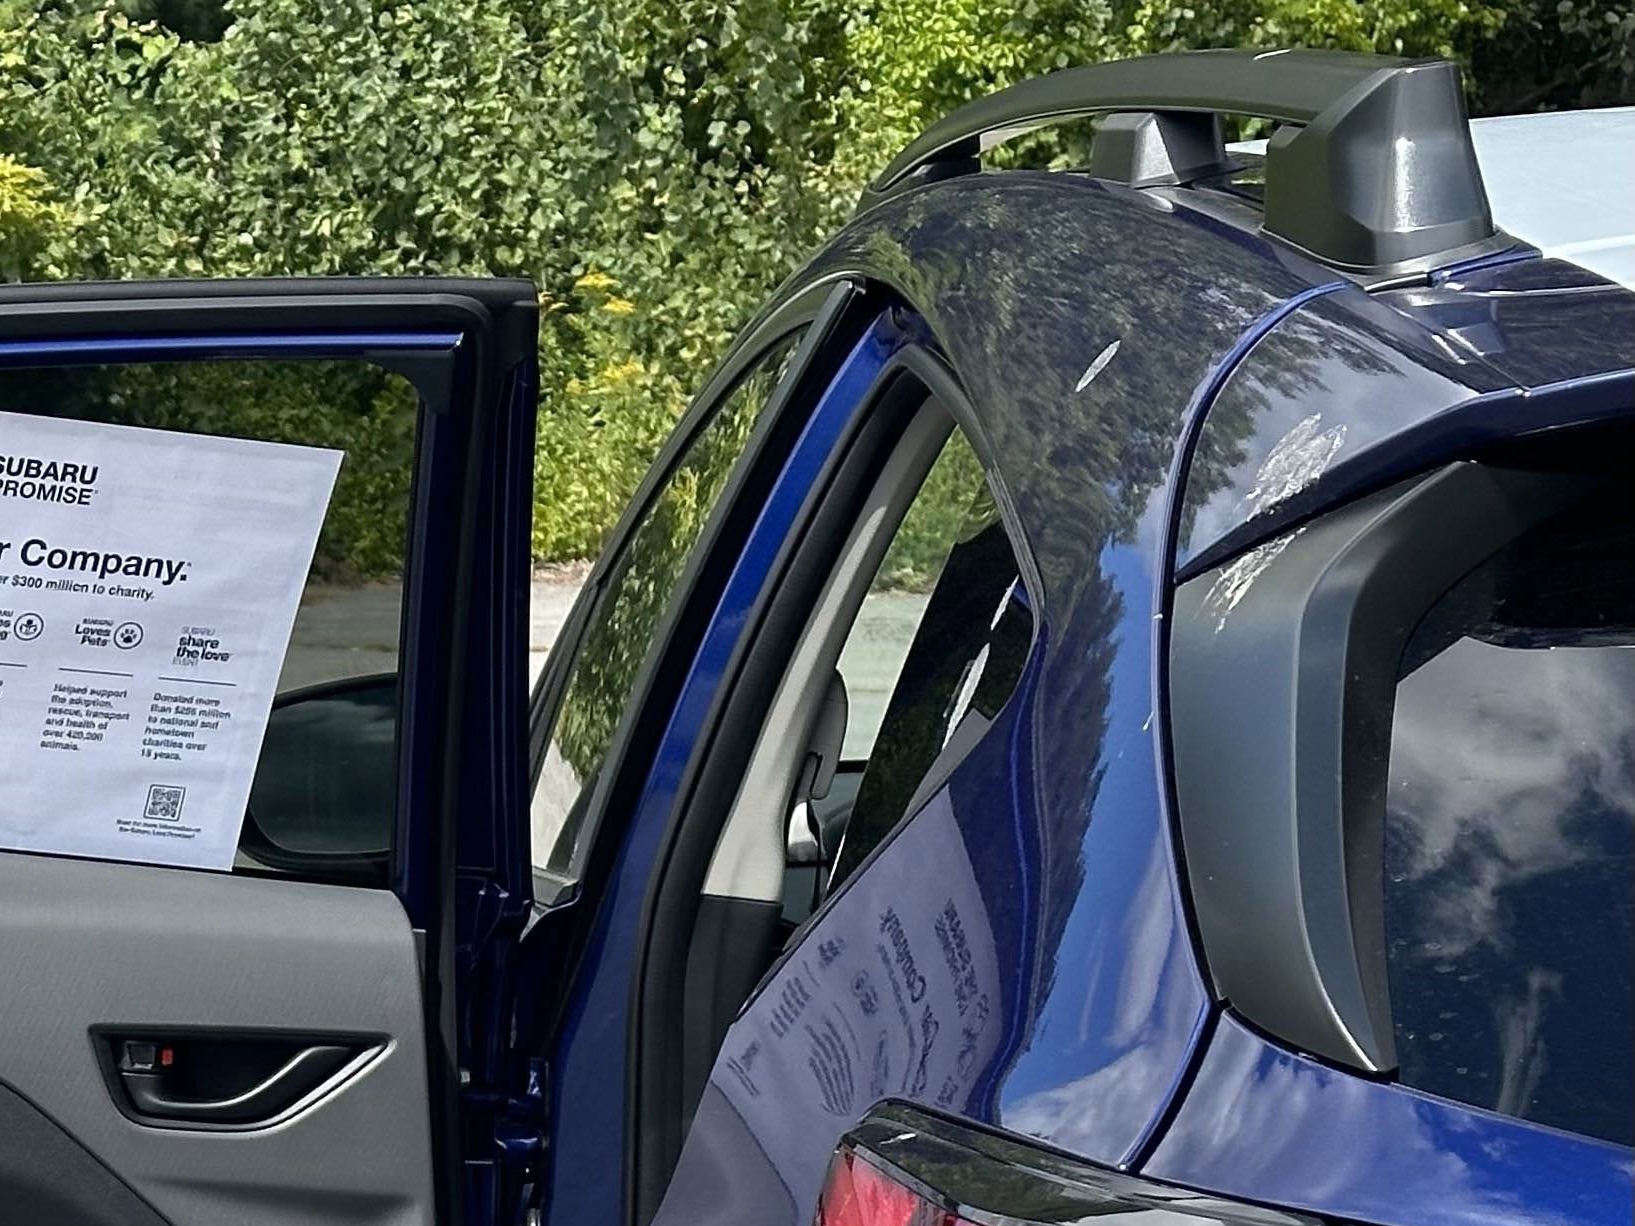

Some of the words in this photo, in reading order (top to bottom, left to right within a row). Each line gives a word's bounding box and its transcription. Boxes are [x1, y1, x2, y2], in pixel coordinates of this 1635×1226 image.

[11, 574, 42, 588] $300
[45, 579, 88, 592] million
[92, 583, 105, 594] to
[108, 584, 153, 601] charity.
[74, 623, 111, 636] Loves
[80, 634, 108, 646] Pets
